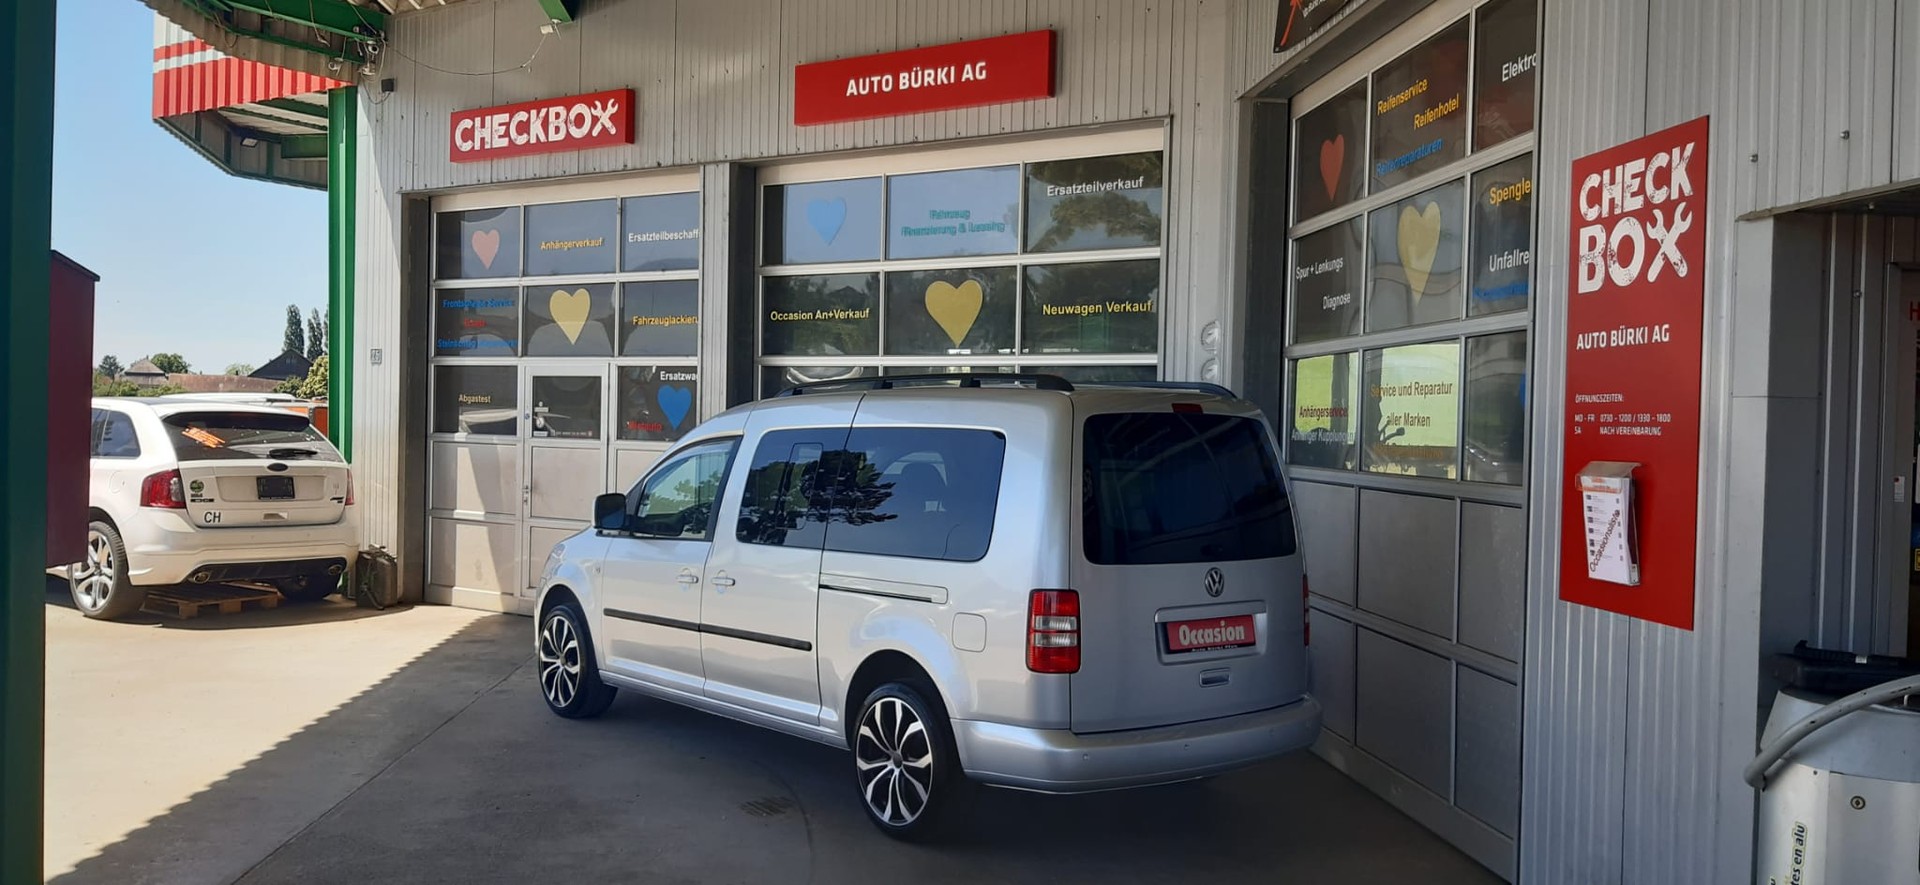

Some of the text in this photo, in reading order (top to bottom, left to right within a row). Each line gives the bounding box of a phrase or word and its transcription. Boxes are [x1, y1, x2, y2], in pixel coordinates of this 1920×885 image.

[846, 61, 988, 97] AUTO BÜRKI AG
[1377, 78, 1428, 115] Reifenservice
[1413, 93, 1459, 130] Reifenhotel
[454, 98, 619, 152] CHECKBOX
[1046, 177, 1144, 198] Ersatzteilverkauf
[1579, 142, 1695, 222] CHECK
[540, 238, 603, 251] Anhängerverkauf
[628, 228, 700, 243] Ersatzteilbeschaff
[1578, 202, 1693, 294] BOX
[1296, 264, 1309, 281] Spur
[1315, 256, 1344, 275] Lenkungs
[1489, 249, 1530, 272] Unfallre
[1042, 300, 1153, 318] Neuwagen Verkauf
[1323, 293, 1351, 311] Diagnose
[770, 307, 870, 322] Occasion An+Verkauf
[1576, 324, 1670, 350] AUTO BÜRKI AG
[458, 394, 491, 405] Abgastest
[1371, 381, 1453, 399] Service und Reparatur
[1386, 412, 1431, 427] aller Marken
[204, 511, 221, 523] CH
[1179, 620, 1245, 646] Occasion
[1794, 825, 1805, 847] alu
[1794, 849, 1803, 865] en
